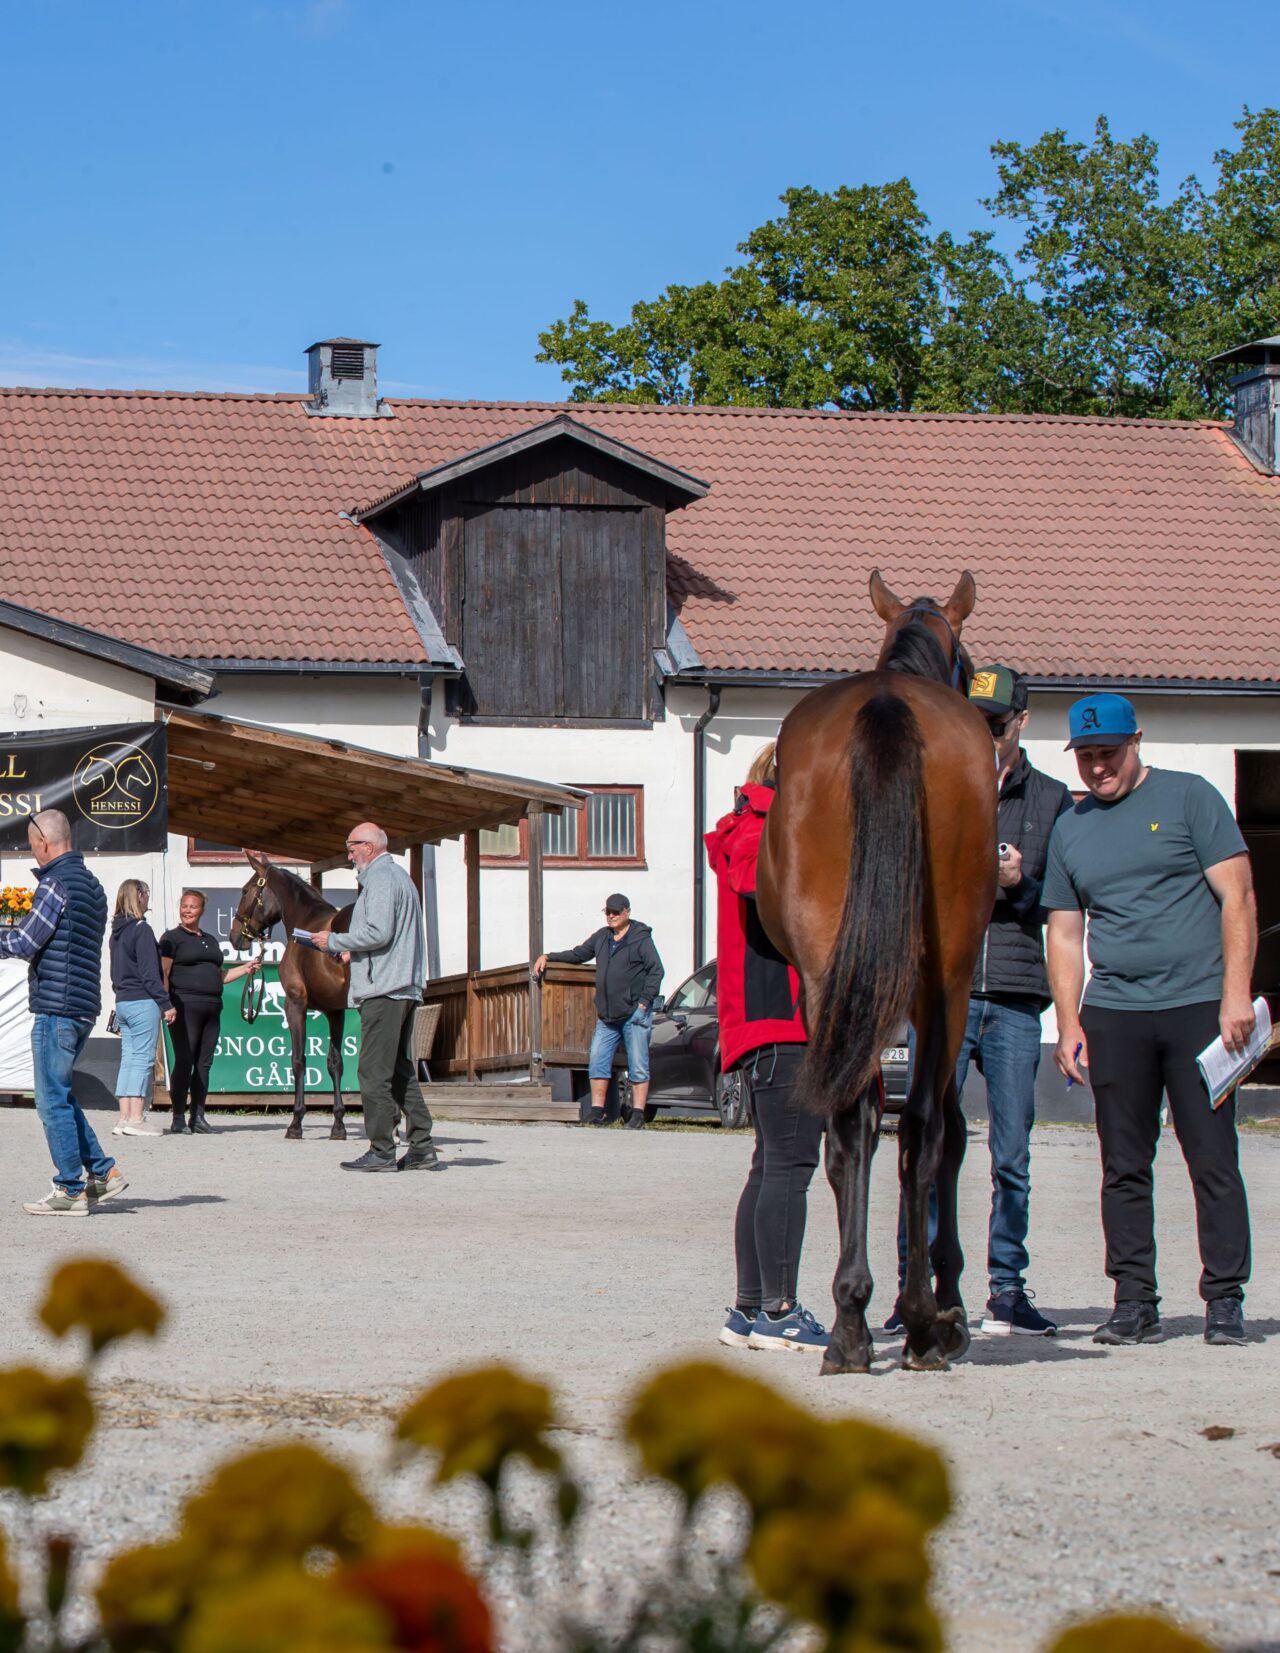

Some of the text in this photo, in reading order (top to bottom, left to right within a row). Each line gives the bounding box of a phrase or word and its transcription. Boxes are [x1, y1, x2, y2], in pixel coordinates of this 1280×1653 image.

[1081, 707, 1101, 730] A
[90, 801, 141, 811] HENESSI
[213, 1036, 358, 1057] SNOGRS
